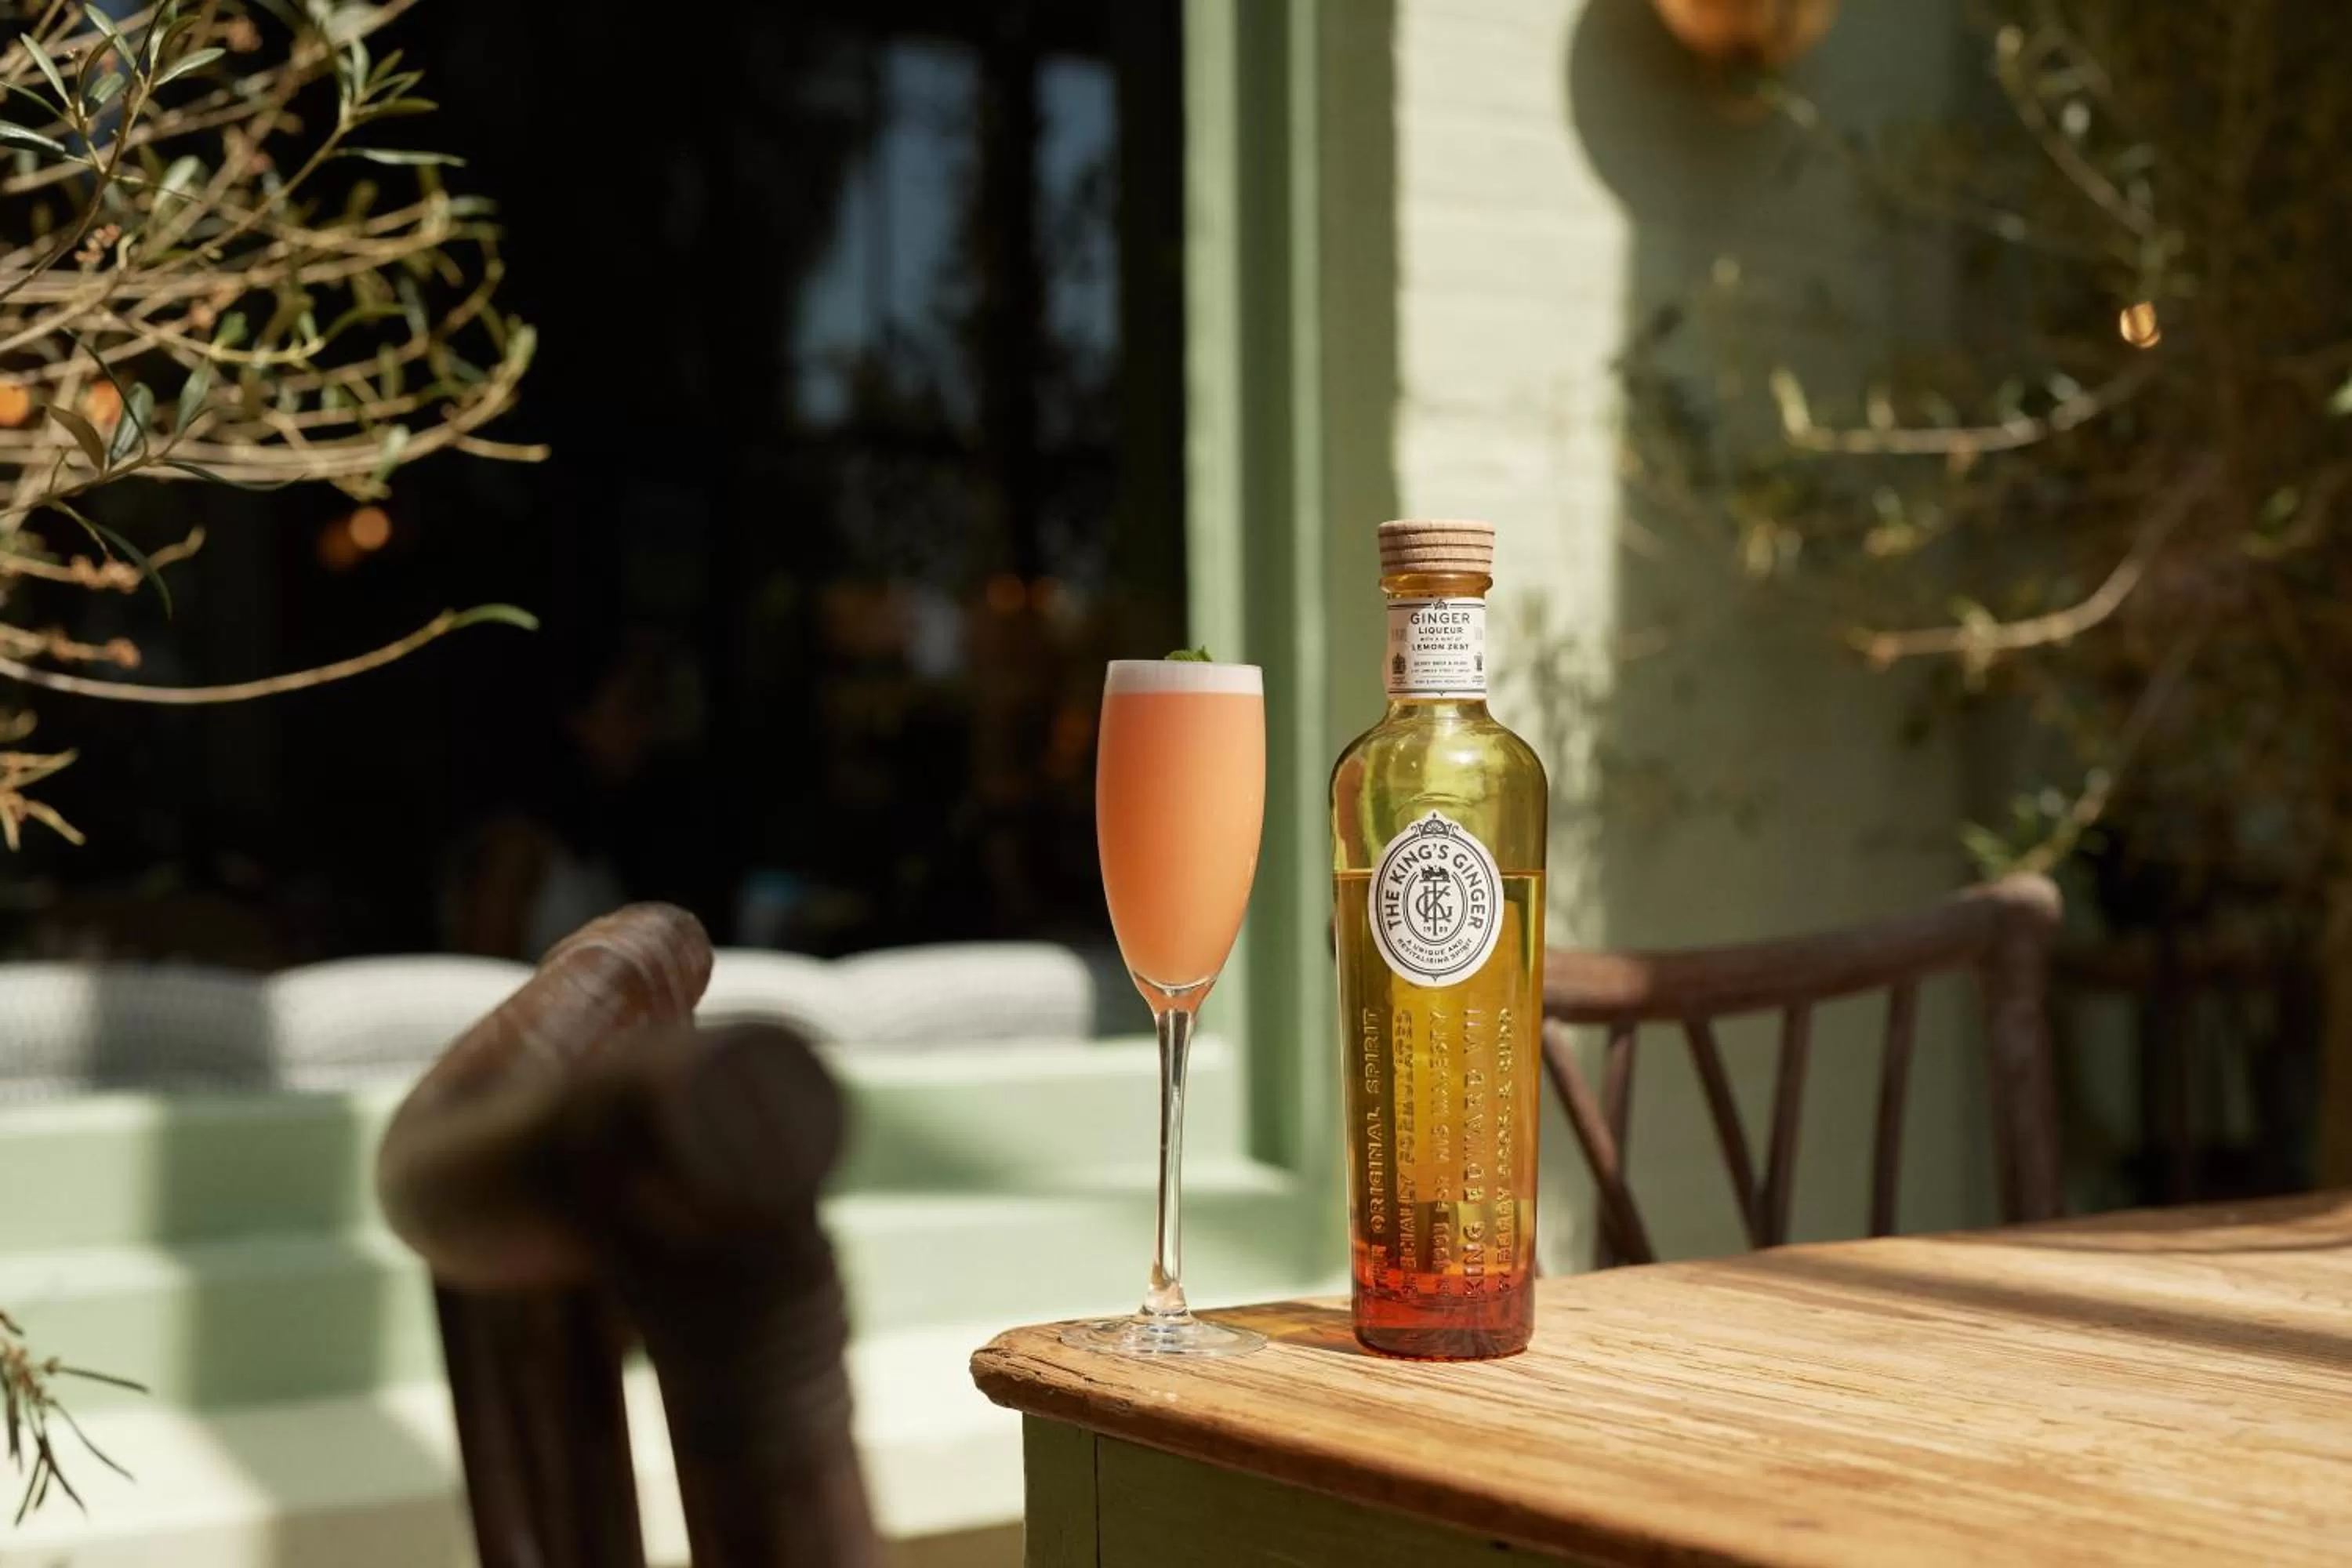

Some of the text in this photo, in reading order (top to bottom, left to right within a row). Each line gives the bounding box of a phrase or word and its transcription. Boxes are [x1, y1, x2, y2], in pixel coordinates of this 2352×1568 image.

[1410, 612, 1470, 624] GINGER
[1385, 843, 1486, 931] THE KING'S GINGER
[1366, 1107, 1386, 1235] ORIGINAL
[1463, 1220, 1486, 1297] KING
